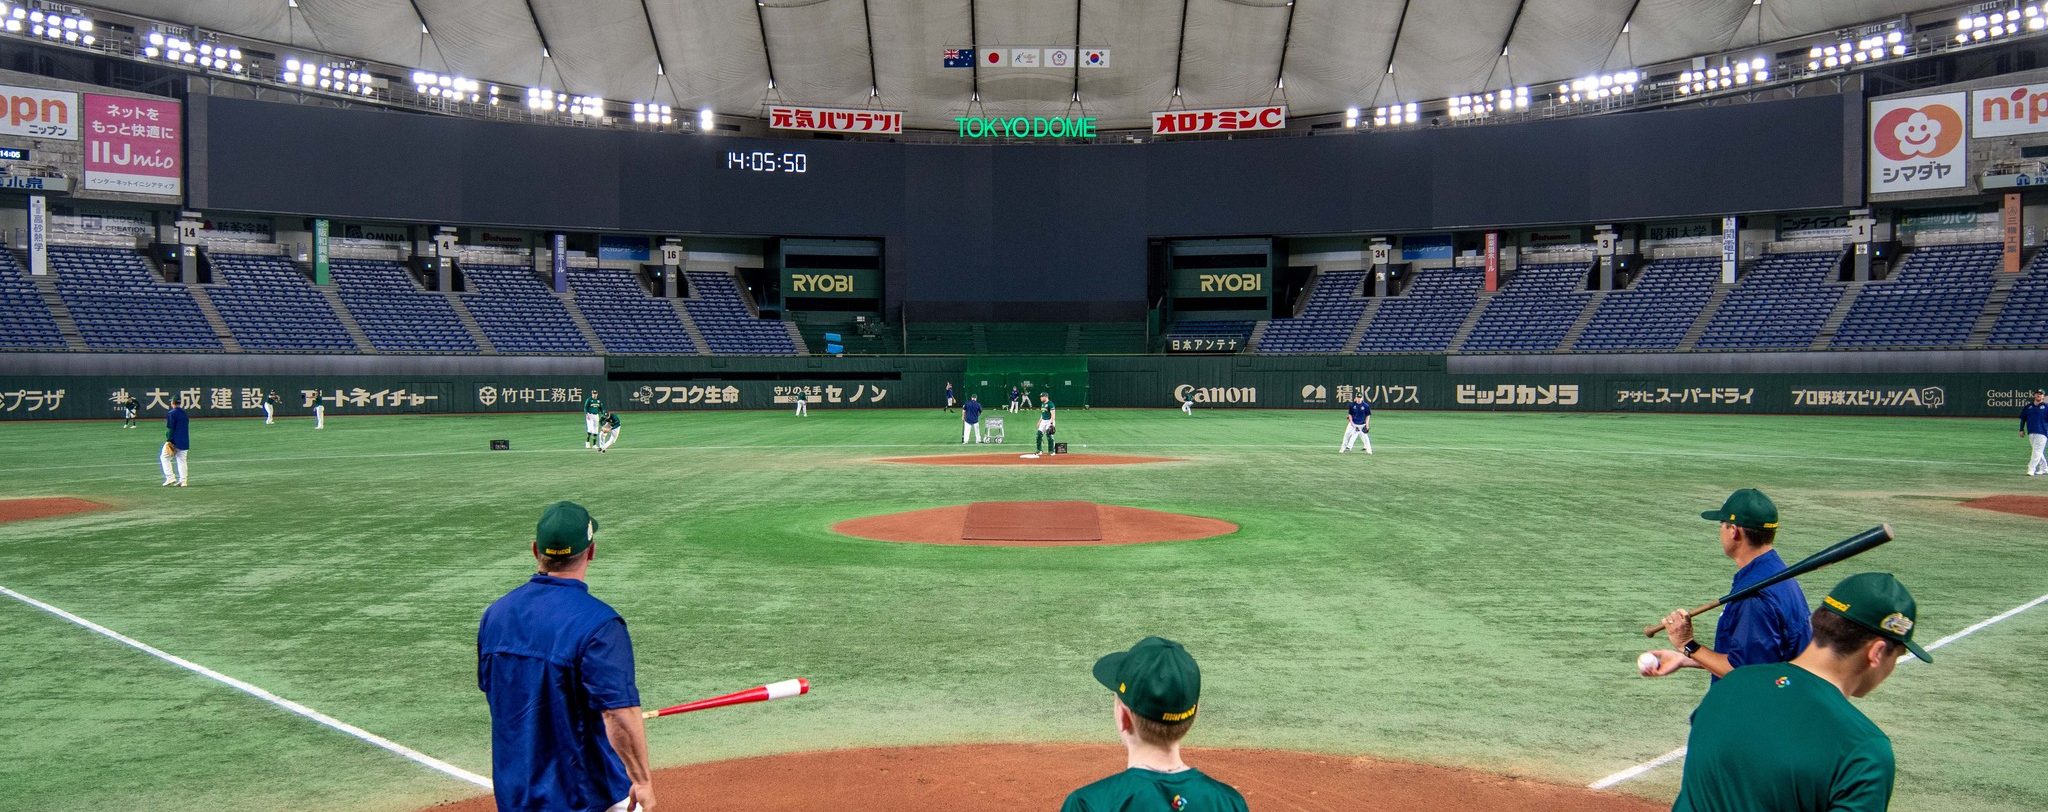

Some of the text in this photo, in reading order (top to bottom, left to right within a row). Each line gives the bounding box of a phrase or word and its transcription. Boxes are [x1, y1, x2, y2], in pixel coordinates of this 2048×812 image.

[107, 104, 160, 121] ネットを
[772, 108, 901, 132] 元気ハツラツ!
[1156, 107, 1282, 132] オロナミンC
[29, 124, 67, 136] ニップン
[92, 121, 174, 140] もっと快適に
[955, 116, 1097, 138] TOKYO DOME
[728, 151, 807, 172] 14:05:50
[1883, 161, 1951, 183] シマダヤ
[184, 227, 195, 237] 14
[1650, 224, 1707, 241] 昭和大学
[1859, 225, 1864, 235] 1
[443, 240, 449, 250] 4
[1603, 240, 1608, 249] 3
[667, 250, 677, 260] 16
[1375, 249, 1385, 259] 34
[792, 274, 854, 292] RYOBI
[1200, 273, 1262, 292] RYOBI
[1172, 339, 1237, 351] 日本アンテナ
[146, 387, 264, 410] 大成建設
[501, 387, 583, 403] 竹中工務店
[654, 385, 740, 404] フコク生命
[774, 385, 822, 396] 守りの名手
[825, 384, 887, 403] セノン
[1174, 384, 1256, 403] Canon
[1336, 384, 1420, 403] 積水ハウス
[1457, 384, 1579, 405] ビックカメラ
[1986, 389, 2013, 399] Good
[1987, 398, 2013, 407] Good
